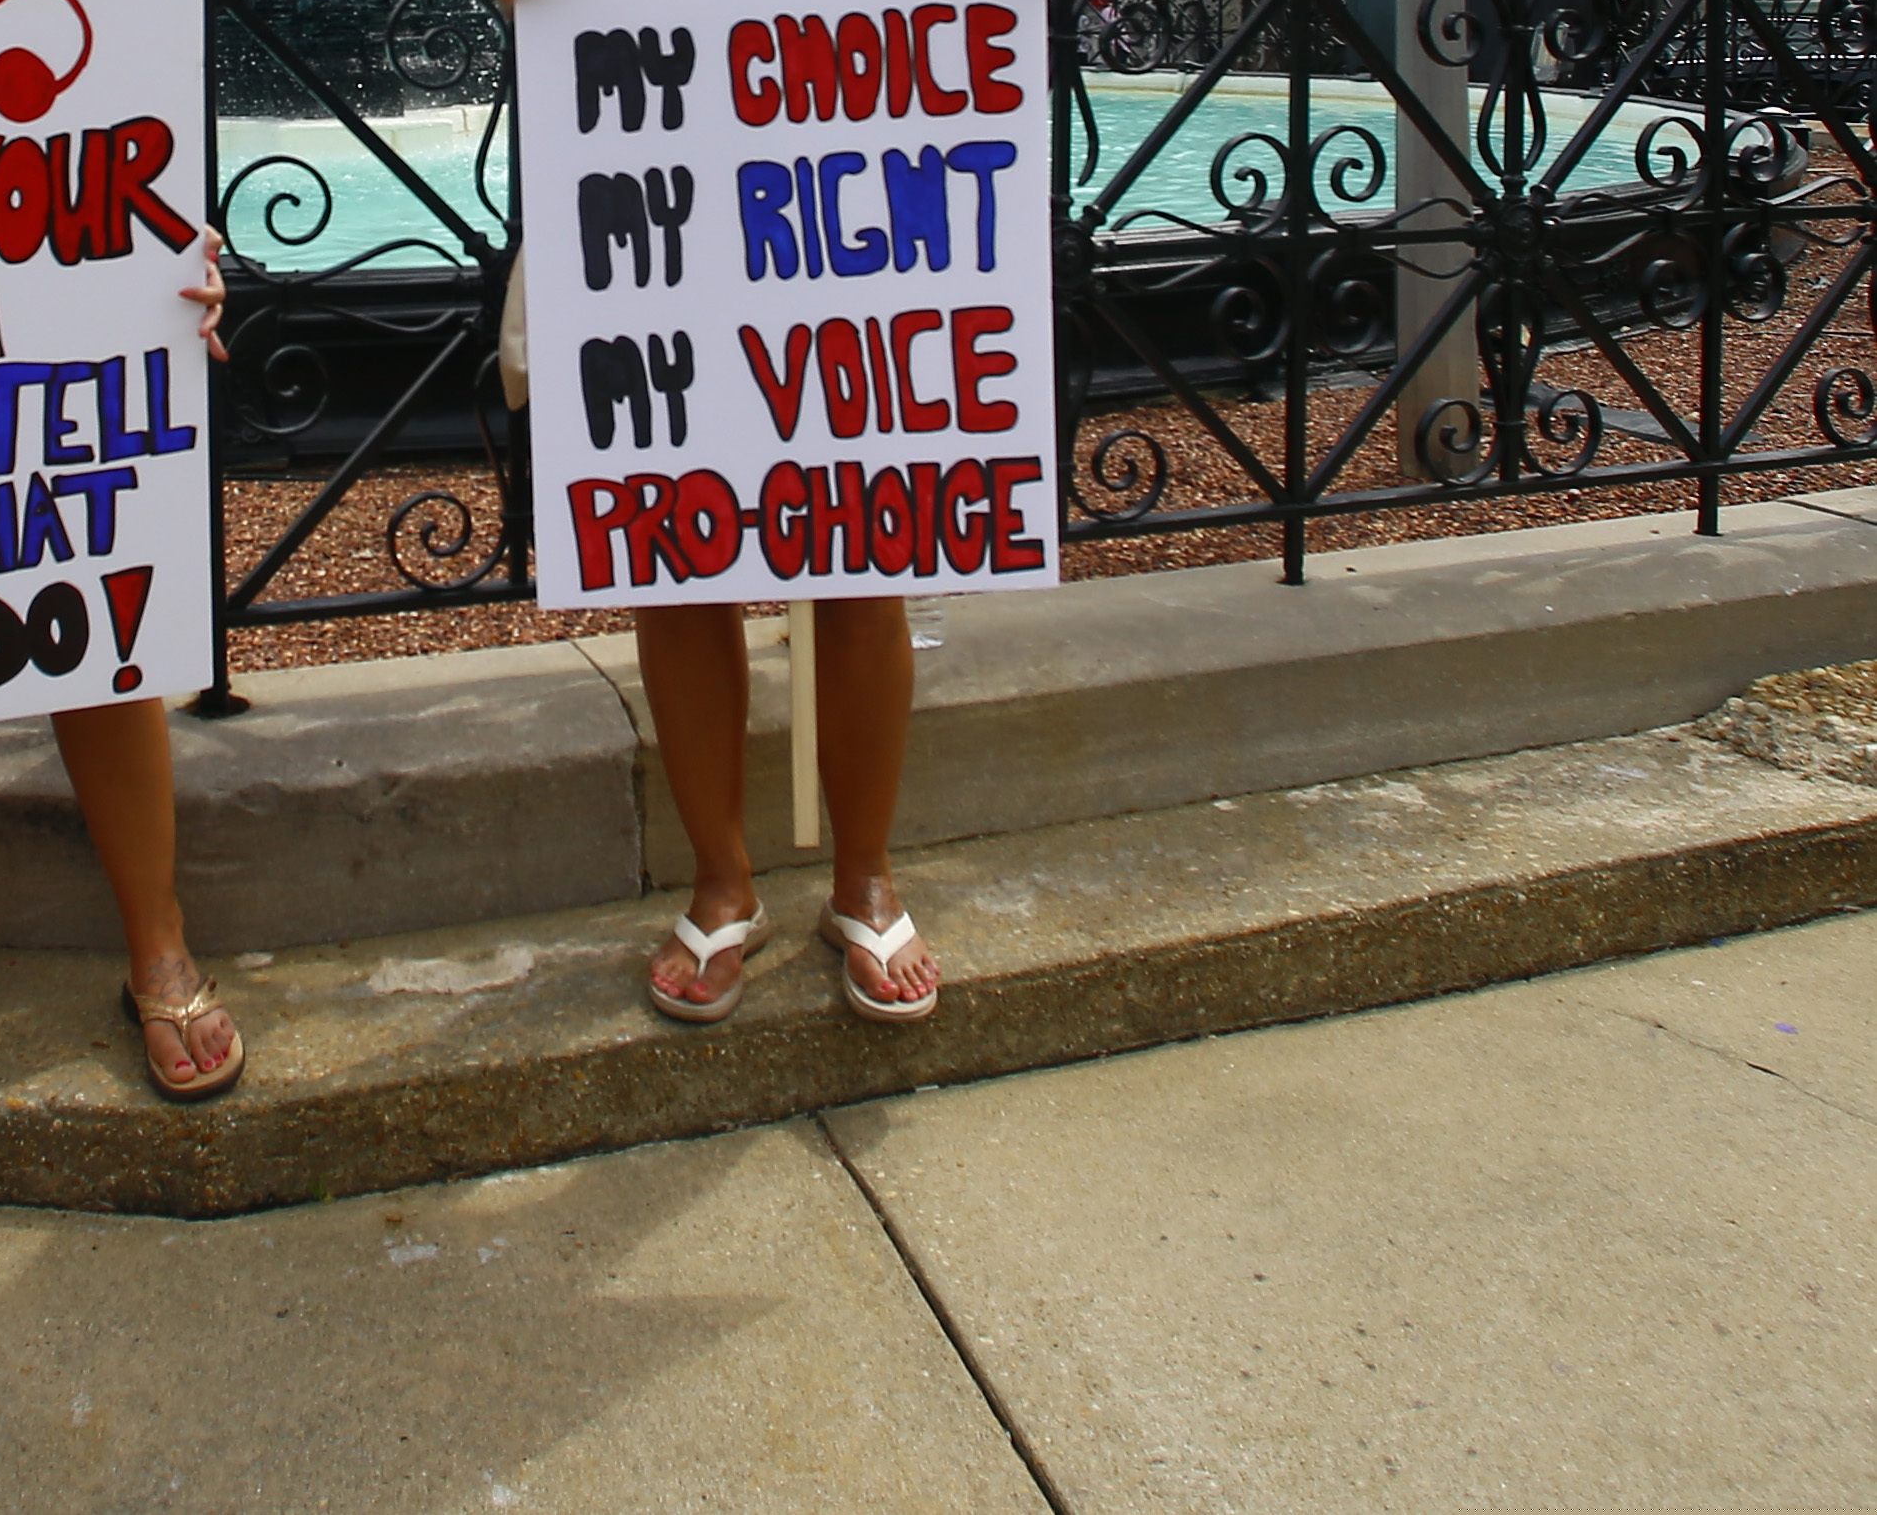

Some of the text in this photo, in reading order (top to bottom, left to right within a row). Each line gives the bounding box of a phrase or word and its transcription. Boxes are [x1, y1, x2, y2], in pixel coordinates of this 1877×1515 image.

[574, 2, 1026, 134] MY CHOICE
[577, 140, 1018, 292] MY RIGHT
[579, 305, 1020, 450] MY VOICE
[566, 453, 1046, 592] PRO-CHOICE
